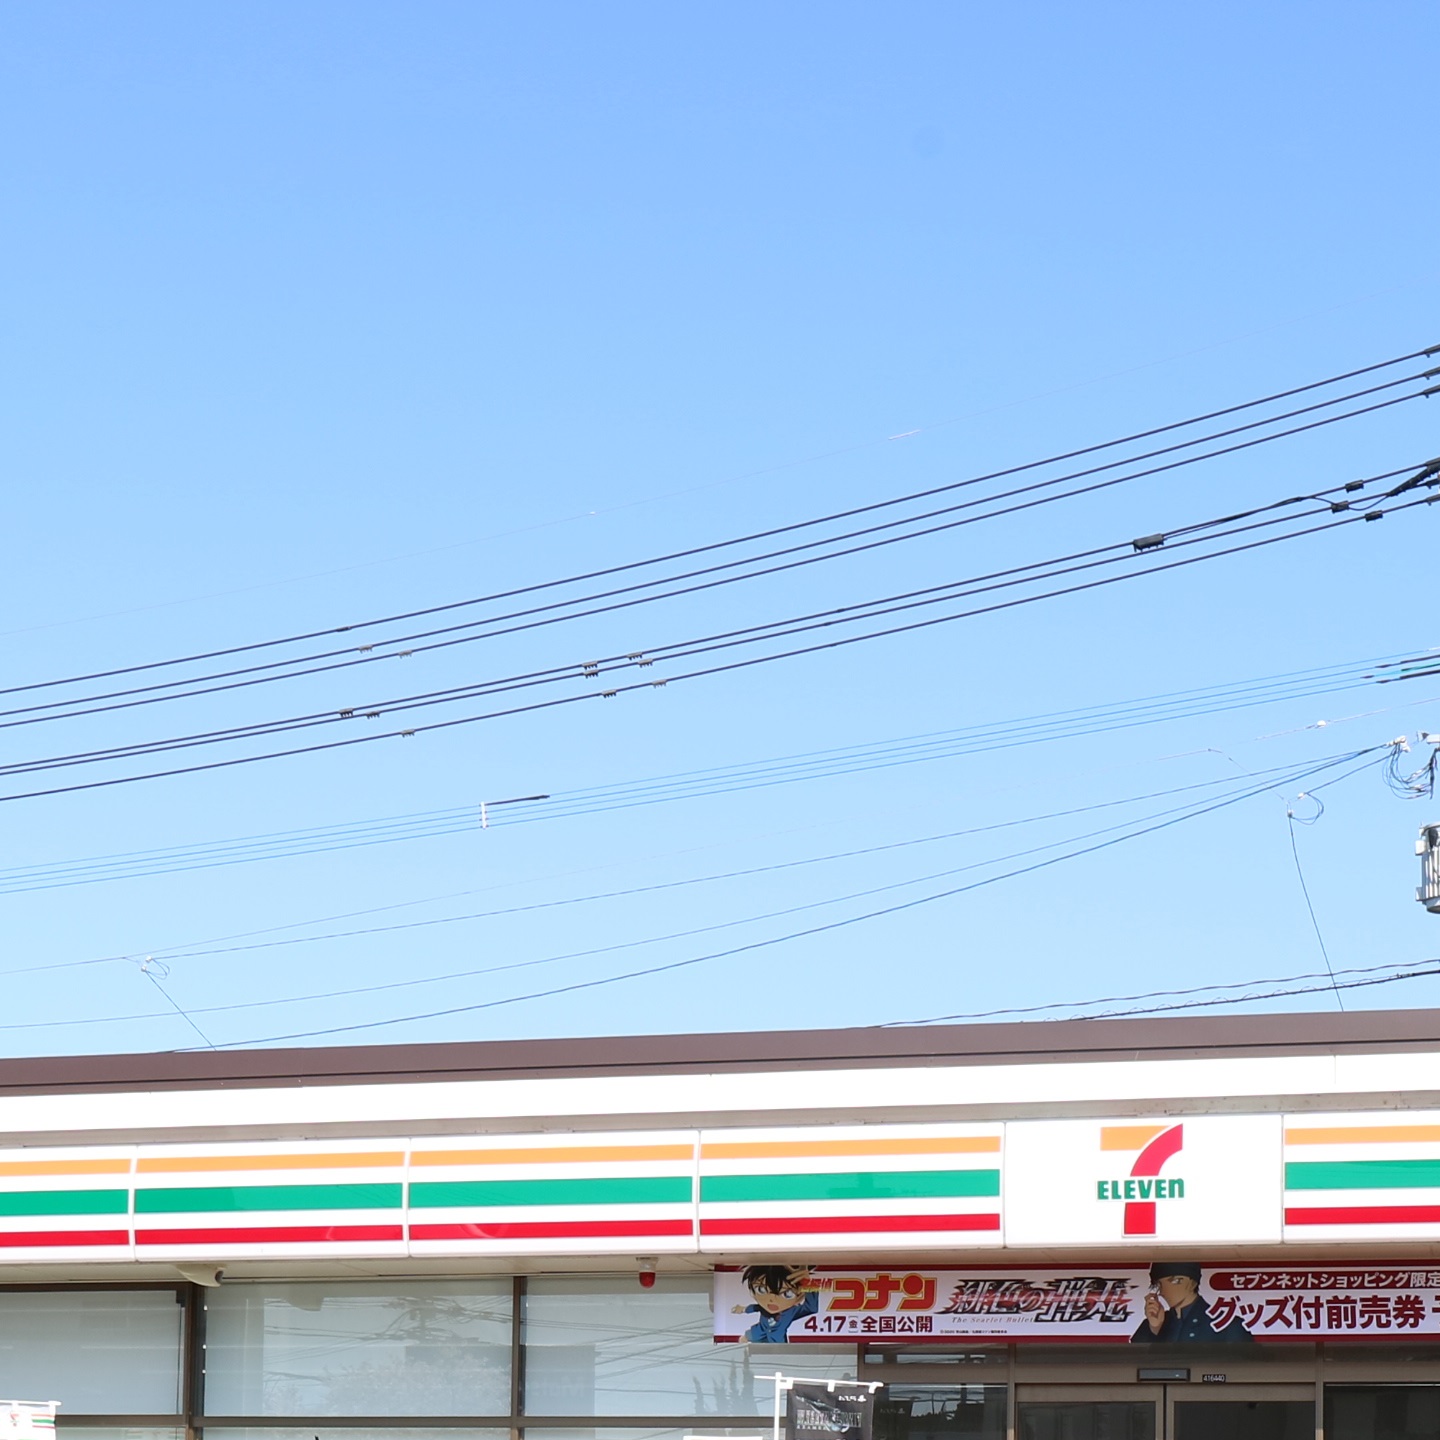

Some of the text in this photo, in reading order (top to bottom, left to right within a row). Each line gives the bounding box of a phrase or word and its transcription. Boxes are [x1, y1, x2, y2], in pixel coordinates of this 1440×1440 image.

[826, 1273, 937, 1312] コナン
[1208, 1295, 1427, 1332] グッズ付前売券
